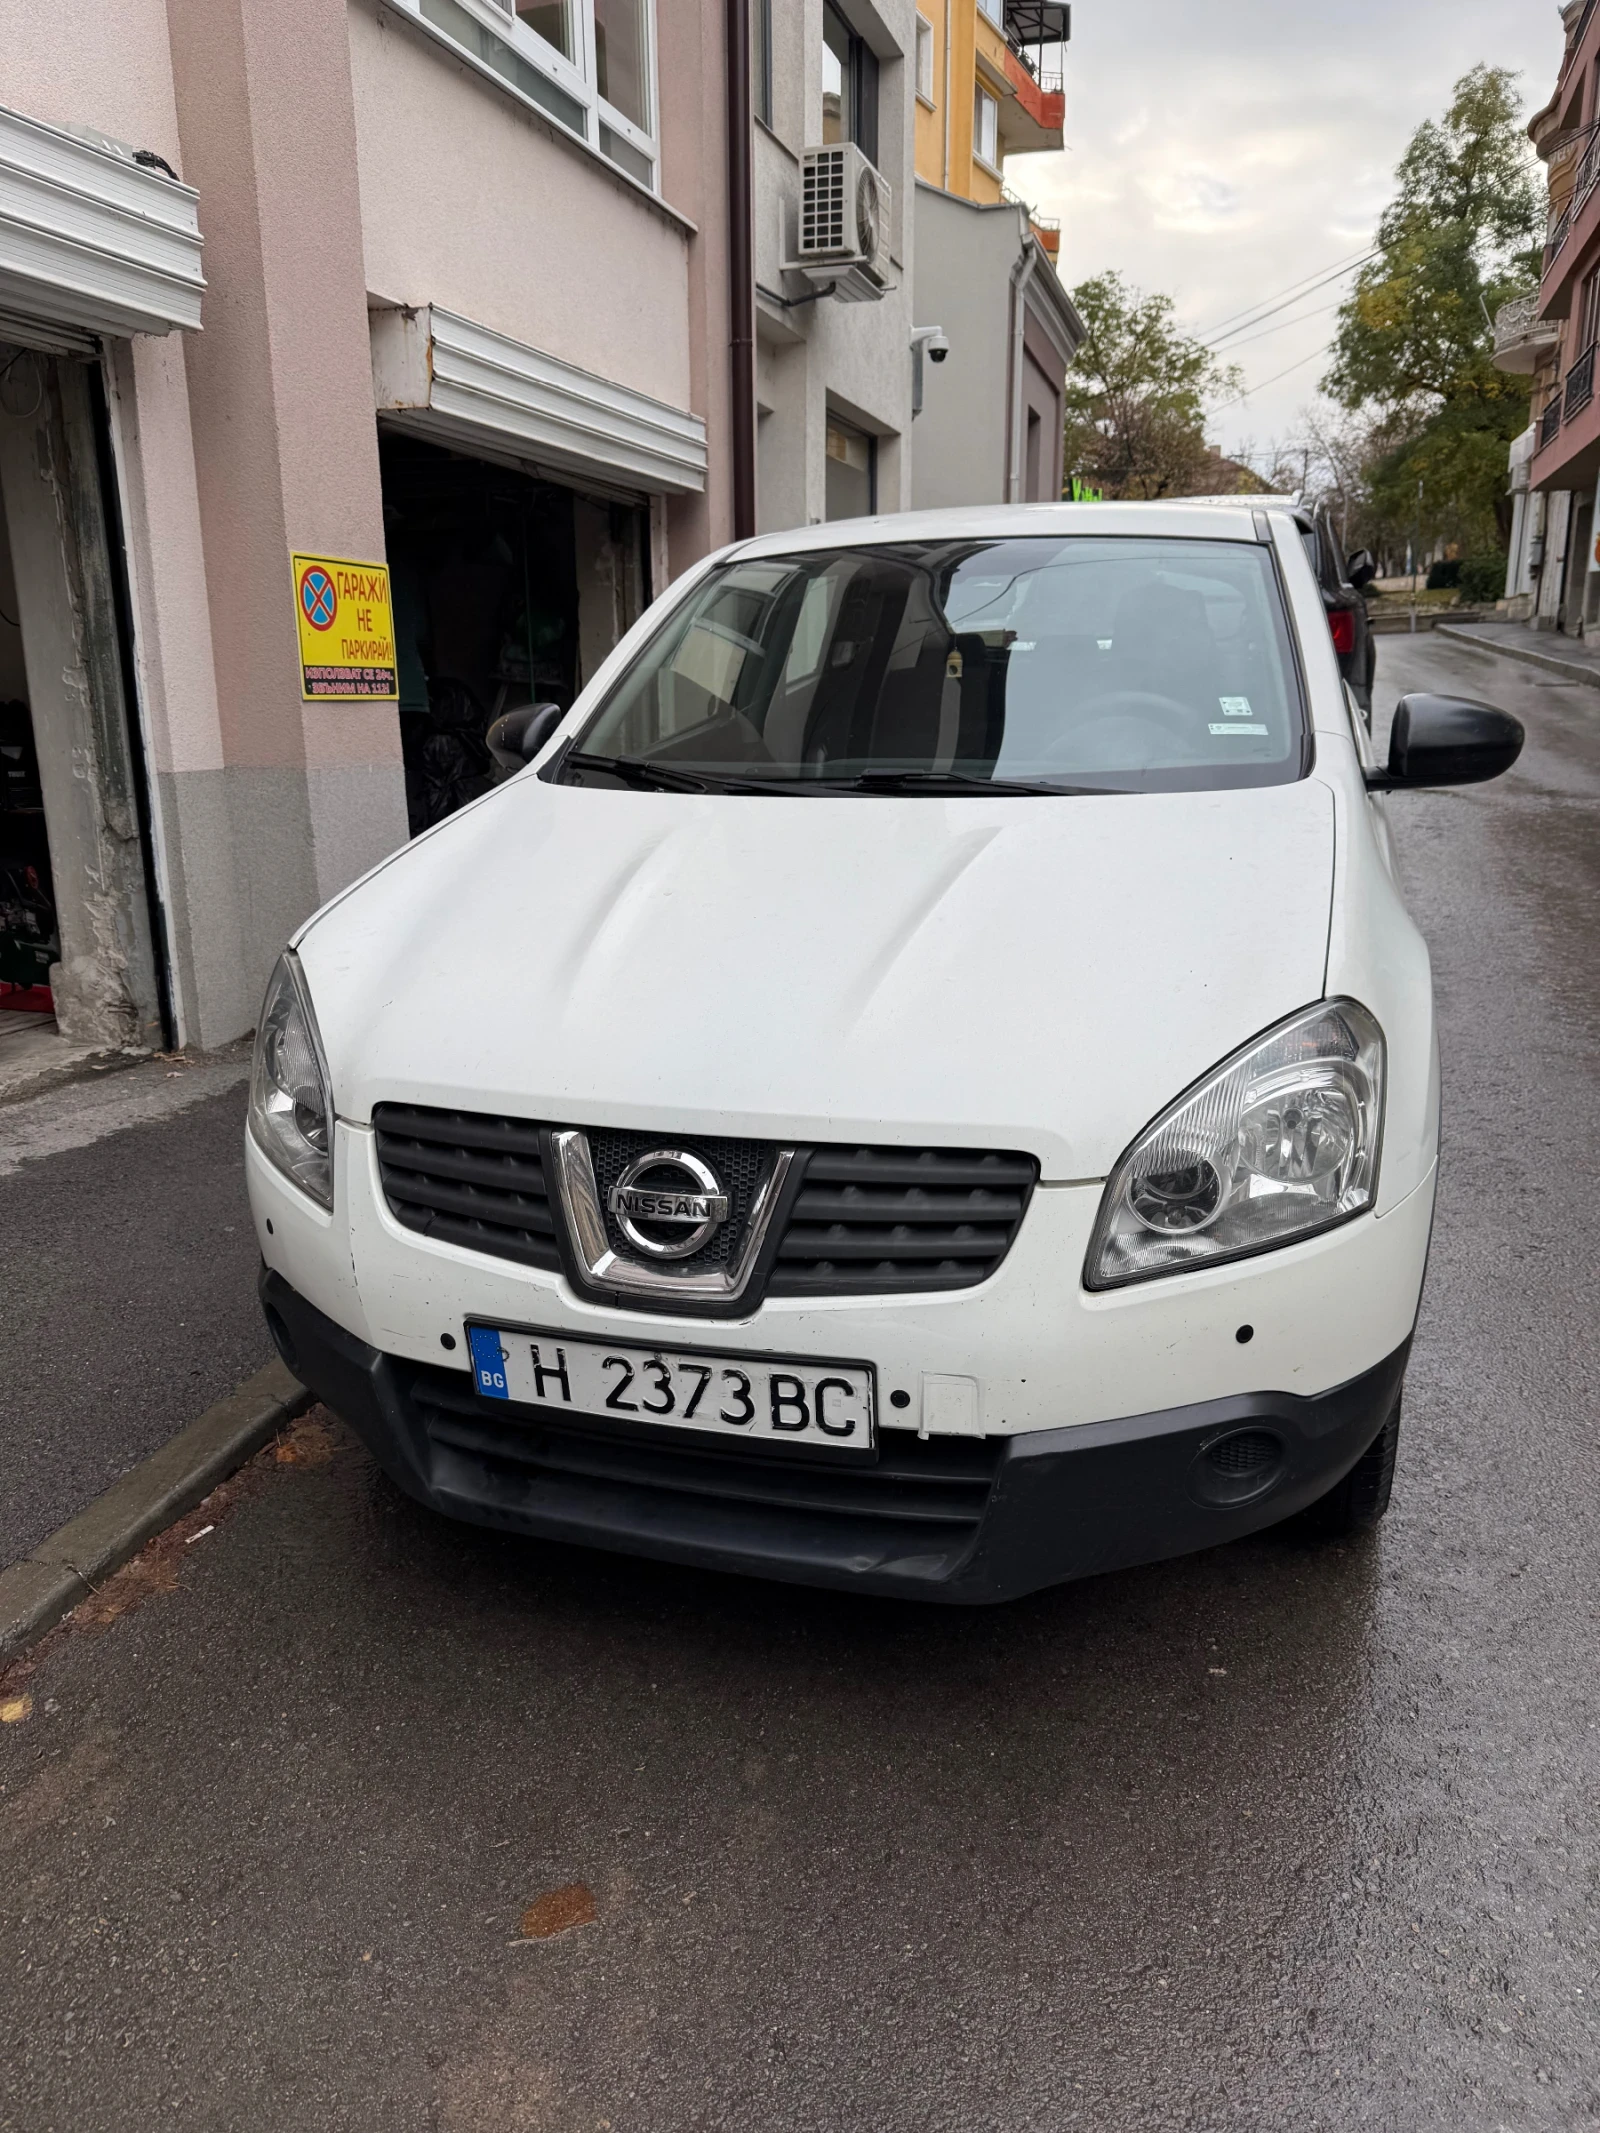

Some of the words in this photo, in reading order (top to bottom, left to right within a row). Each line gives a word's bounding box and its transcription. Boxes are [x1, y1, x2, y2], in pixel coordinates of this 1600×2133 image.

[337, 572, 387, 603] ГАРАЖИ
[356, 608, 373, 632] НЕ
[341, 637, 393, 661] ПАРКИРАЙ!
[305, 667, 361, 680] ИЗПОЛЗВАТ
[363, 668, 375, 680] СЕ
[357, 683, 371, 694] НА
[617, 1194, 712, 1218] NISSAN
[481, 1370, 504, 1388] BG
[602, 1355, 755, 1426] 2373
